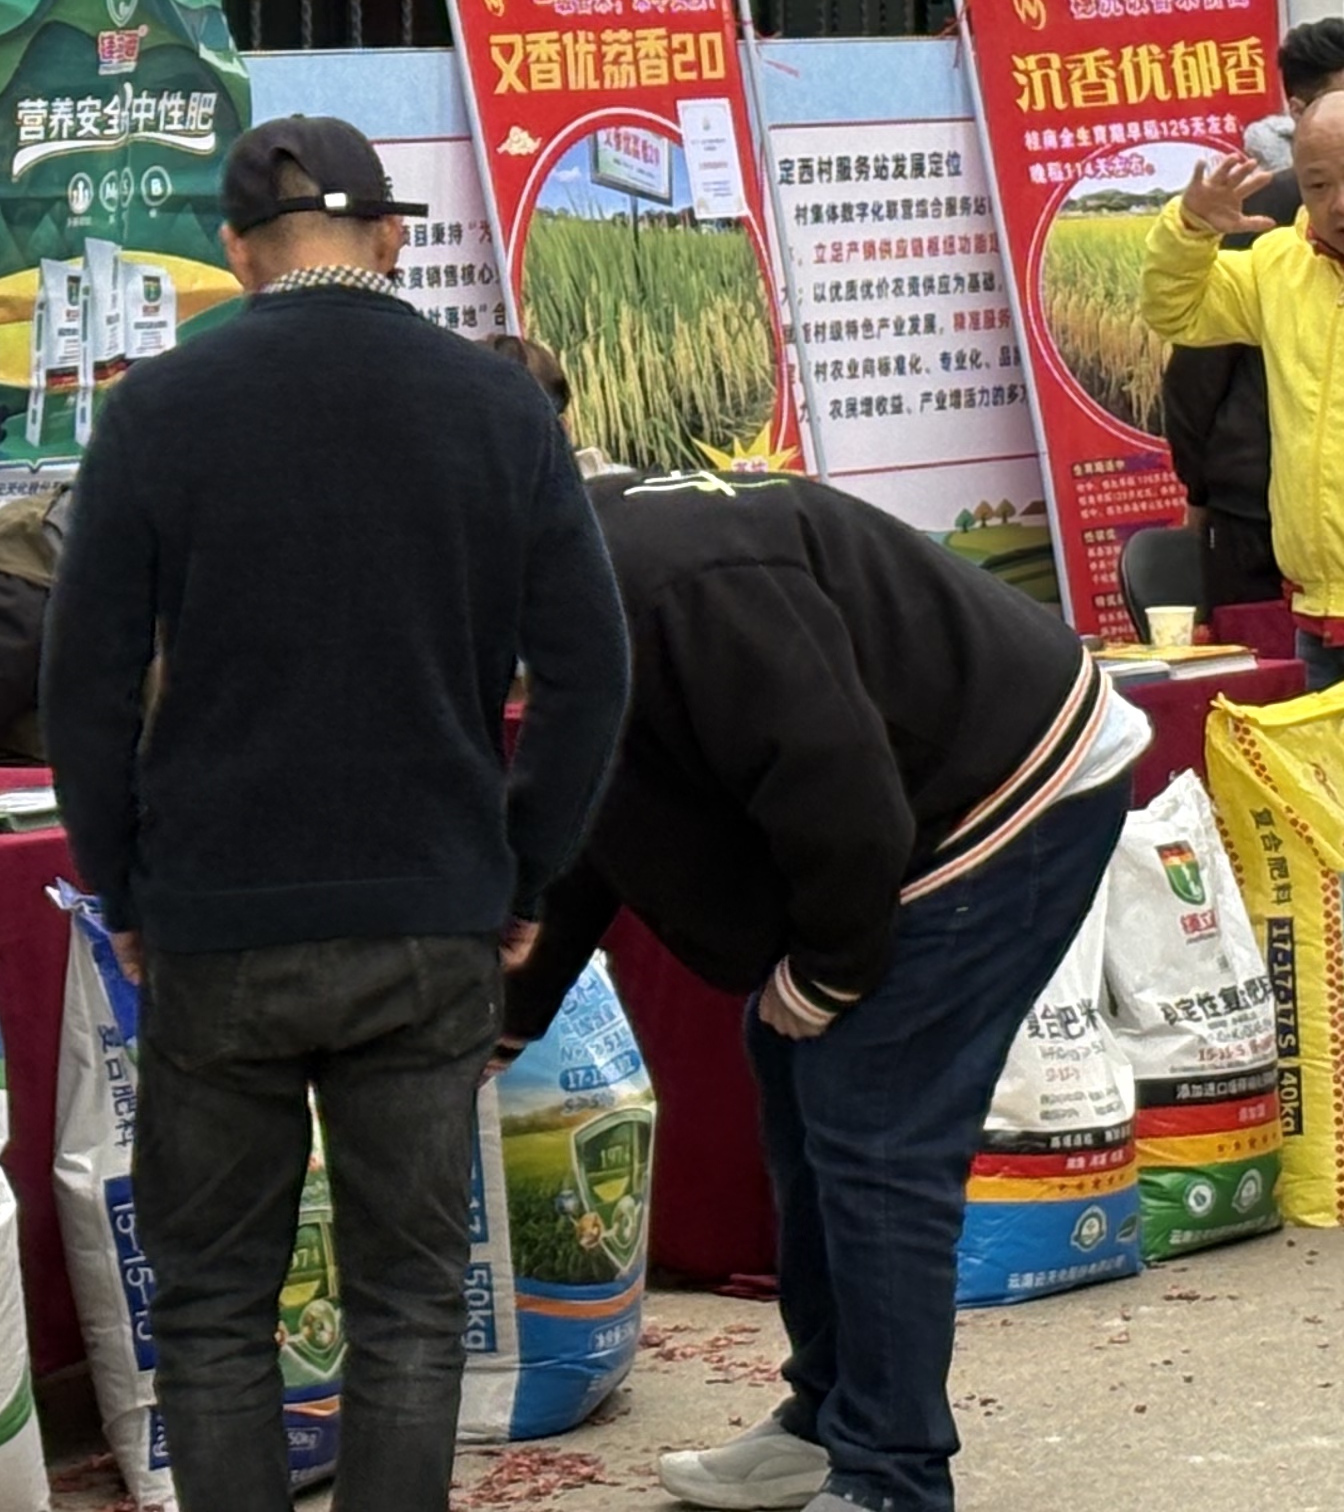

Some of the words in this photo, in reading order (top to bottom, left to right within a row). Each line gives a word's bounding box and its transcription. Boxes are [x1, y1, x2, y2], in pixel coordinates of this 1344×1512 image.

[489, 27, 726, 95] 又香优荔香20
[1012, 36, 1266, 113] 沉香优郁香
[778, 151, 962, 185] 定西村服务站发展定位
[795, 195, 993, 226] 村集体数字化联营综合服务站
[1250, 807, 1293, 906] 复合肥料
